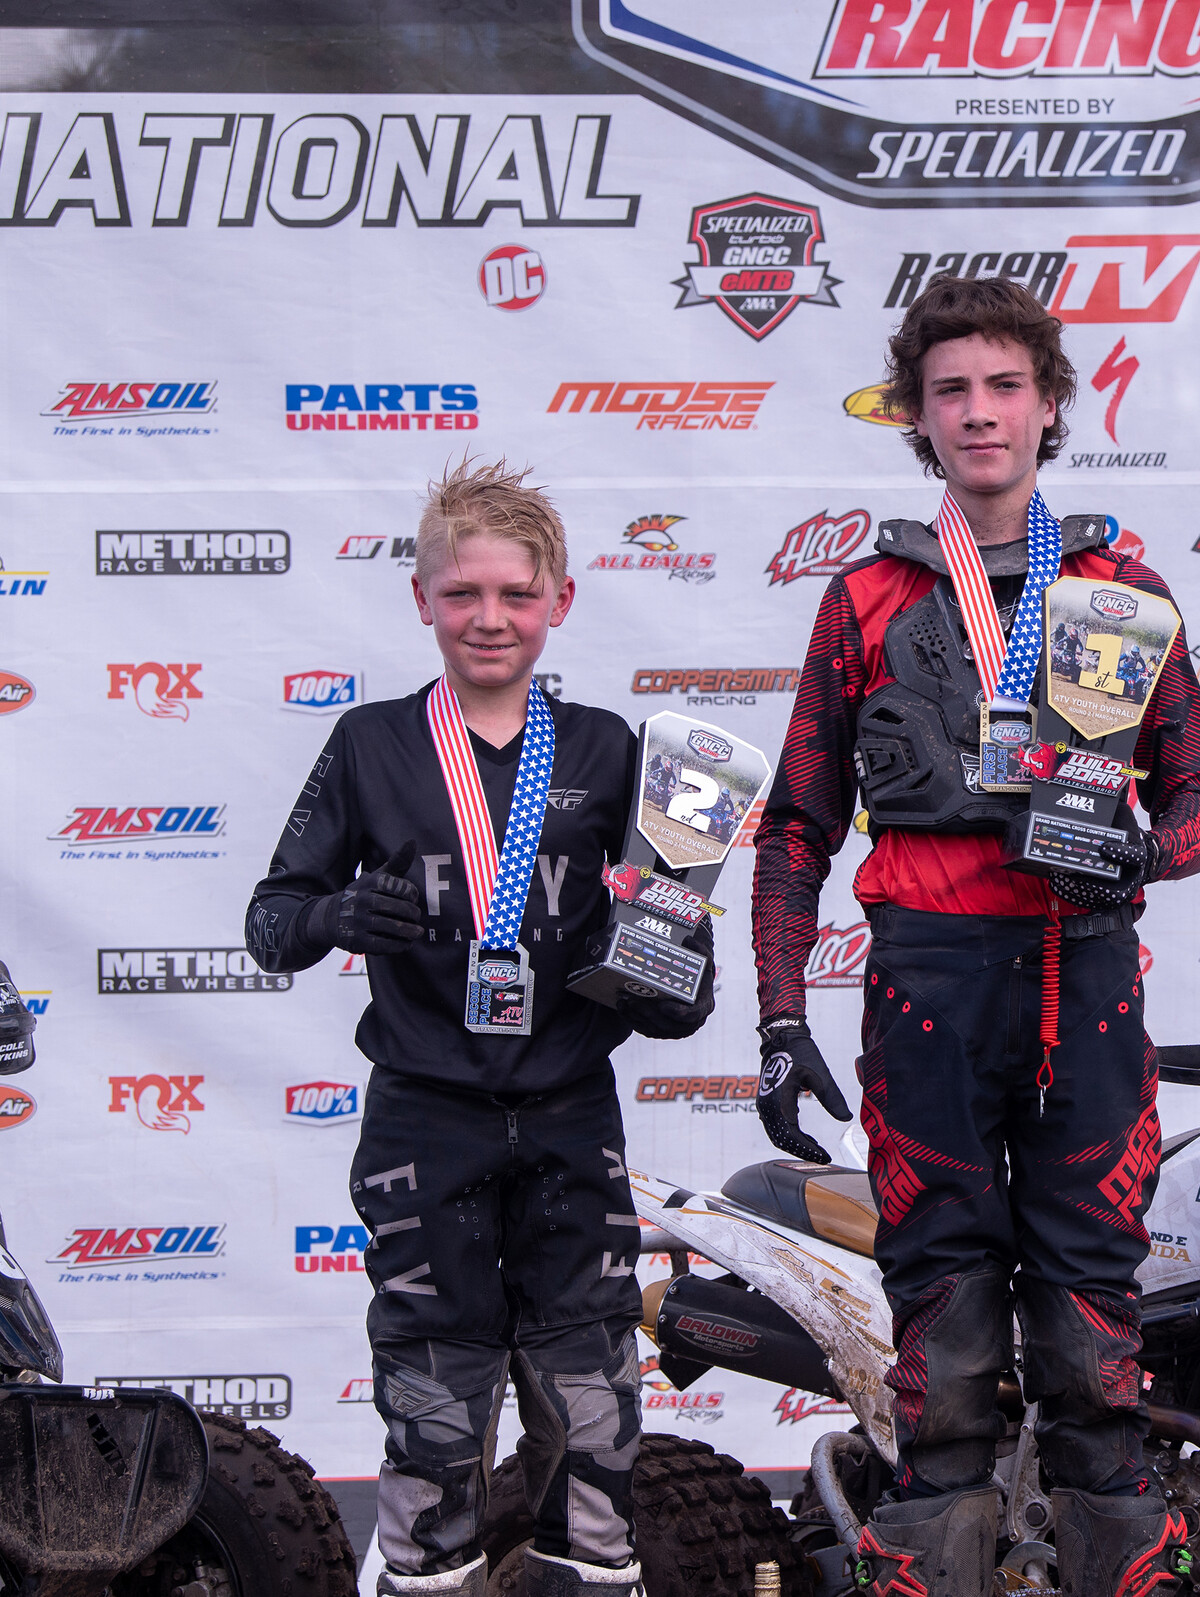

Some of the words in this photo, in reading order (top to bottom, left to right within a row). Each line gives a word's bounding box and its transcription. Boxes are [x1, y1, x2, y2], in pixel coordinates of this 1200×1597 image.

[956, 98, 1079, 117] PRESENTED
[1087, 98, 1116, 115] BY
[857, 129, 1187, 180] SPECIALIZED
[703, 216, 808, 233] SPECIALIZED
[723, 246, 792, 265] GNCC
[486, 252, 542, 306] DC
[720, 270, 794, 291] eMTB
[50, 382, 217, 418] AMSOIL
[286, 384, 477, 411] PARTS
[547, 382, 777, 413] MOOSE
[53, 427, 77, 435] The
[81, 427, 115, 435] First
[121, 427, 131, 435] in
[136, 427, 211, 437] Synthetics
[286, 414, 478, 431] UNLIMITED
[636, 414, 753, 430] RACING
[1067, 452, 1167, 468] SPECIALIZED
[100, 534, 286, 559] METHOD
[101, 560, 164, 571] RACE
[181, 560, 287, 571] WHEELS
[587, 554, 634, 569] ALL
[637, 553, 715, 568] BALLS
[668, 567, 716, 585] Racing
[1094, 596, 1135, 613] GNCC
[1078, 634, 1126, 696] 1
[107, 662, 203, 703] FOX
[288, 676, 351, 702] 100%
[1054, 694, 1070, 703] ATV
[1072, 697, 1098, 710] YOUTH
[1100, 703, 1136, 719] OVERALL
[993, 727, 1030, 738] GNCC
[690, 734, 729, 756] GNCC
[983, 743, 996, 784] FIRST
[997, 748, 1008, 784] PLACE
[1068, 754, 1123, 775] WILD
[1057, 764, 1124, 789] BOAR
[665, 768, 720, 833] 2
[1088, 785, 1117, 795] FLORIDA
[1056, 792, 1095, 813] AMA
[58, 806, 227, 841] AMSOIL
[1035, 817, 1050, 825] GRAND
[1051, 820, 1072, 830] NATIONAL
[1072, 825, 1086, 833] CROSS
[643, 820, 658, 831] ATV
[660, 826, 686, 842] YOUTH
[686, 837, 720, 857] OVERALL
[59, 851, 85, 860] The
[89, 851, 122, 860] First
[127, 851, 139, 860] in
[145, 851, 220, 862] Synthetics
[638, 888, 703, 921] BOAR
[651, 881, 703, 908] WILD
[634, 916, 673, 939] AMA
[667, 912, 695, 928] FLORIDA
[481, 967, 517, 978] GNCC
[102, 978, 167, 990] RACE
[183, 977, 290, 990] WHEELS
[469, 983, 480, 1024] SECOND
[480, 988, 492, 1025] PLACE
[501, 1006, 523, 1018] ATV
[109, 1074, 204, 1115] FOX
[291, 1087, 355, 1113] 100%
[57, 1226, 227, 1261] AMSOIL
[58, 1273, 84, 1283] The
[88, 1273, 121, 1283] First
[126, 1273, 139, 1282] in
[143, 1272, 219, 1284] Synthetics
[675, 1315, 761, 1347] BALDWIN
[694, 1334, 744, 1352] Motorsports
[646, 1392, 723, 1408] BALLS
[675, 1408, 724, 1425] Racing
